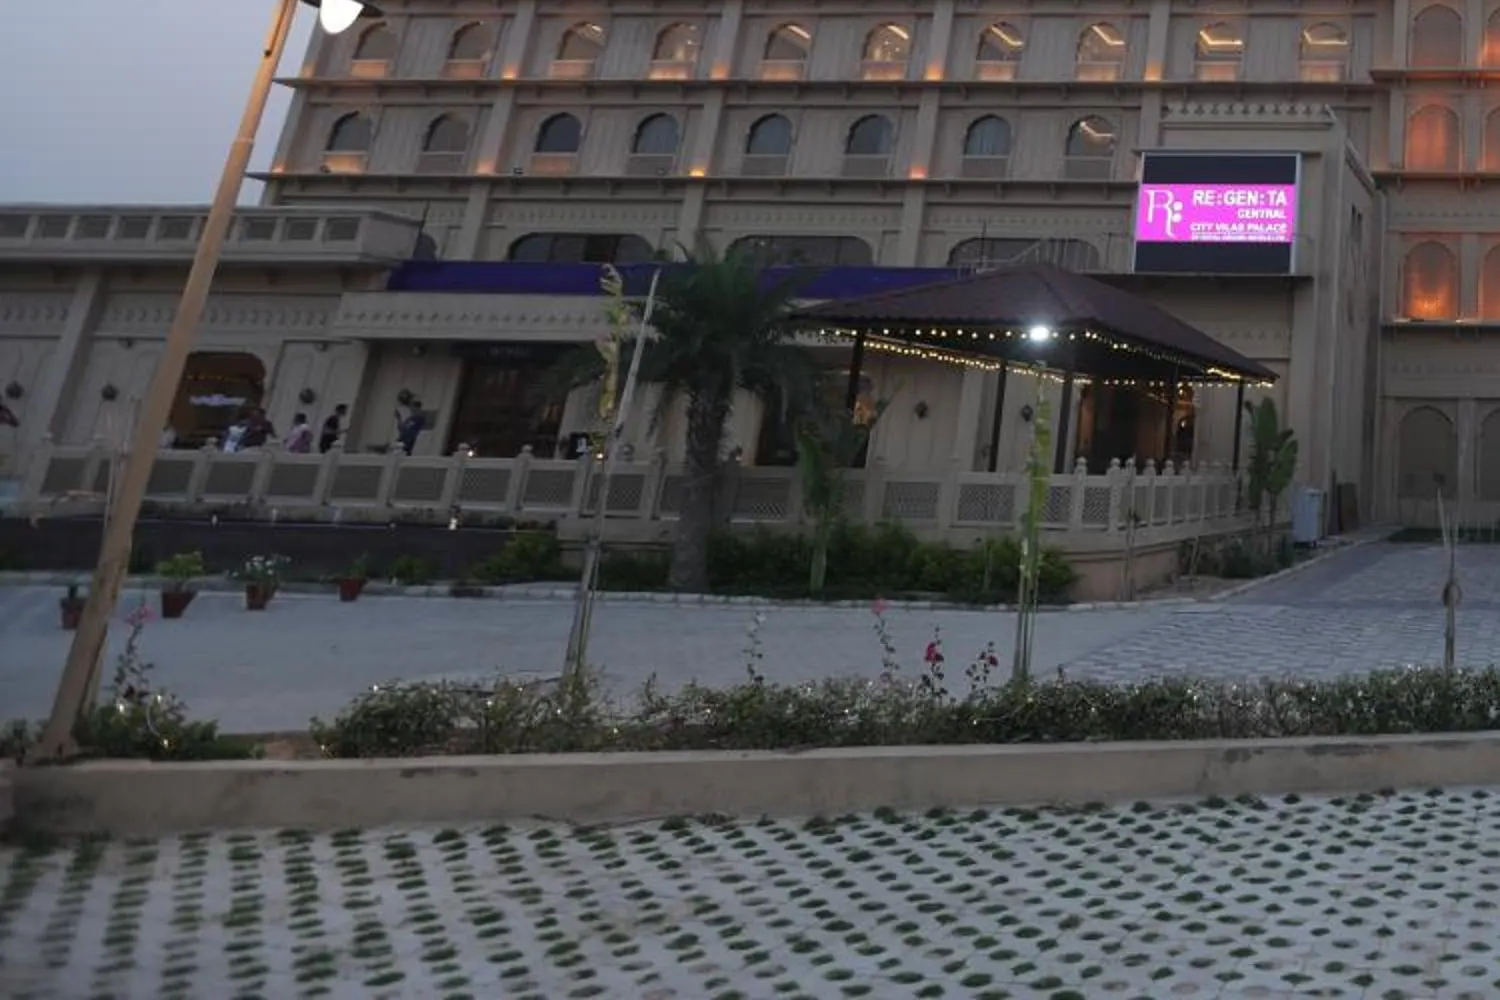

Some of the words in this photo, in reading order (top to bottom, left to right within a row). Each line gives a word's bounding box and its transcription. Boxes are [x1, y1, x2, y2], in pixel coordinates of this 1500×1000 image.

[1193, 189, 1287, 206] RE:GEN:TA
[1238, 208, 1287, 219] CENTRAL
[1190, 223, 1214, 231] CITY
[1247, 223, 1288, 232] PALACE
